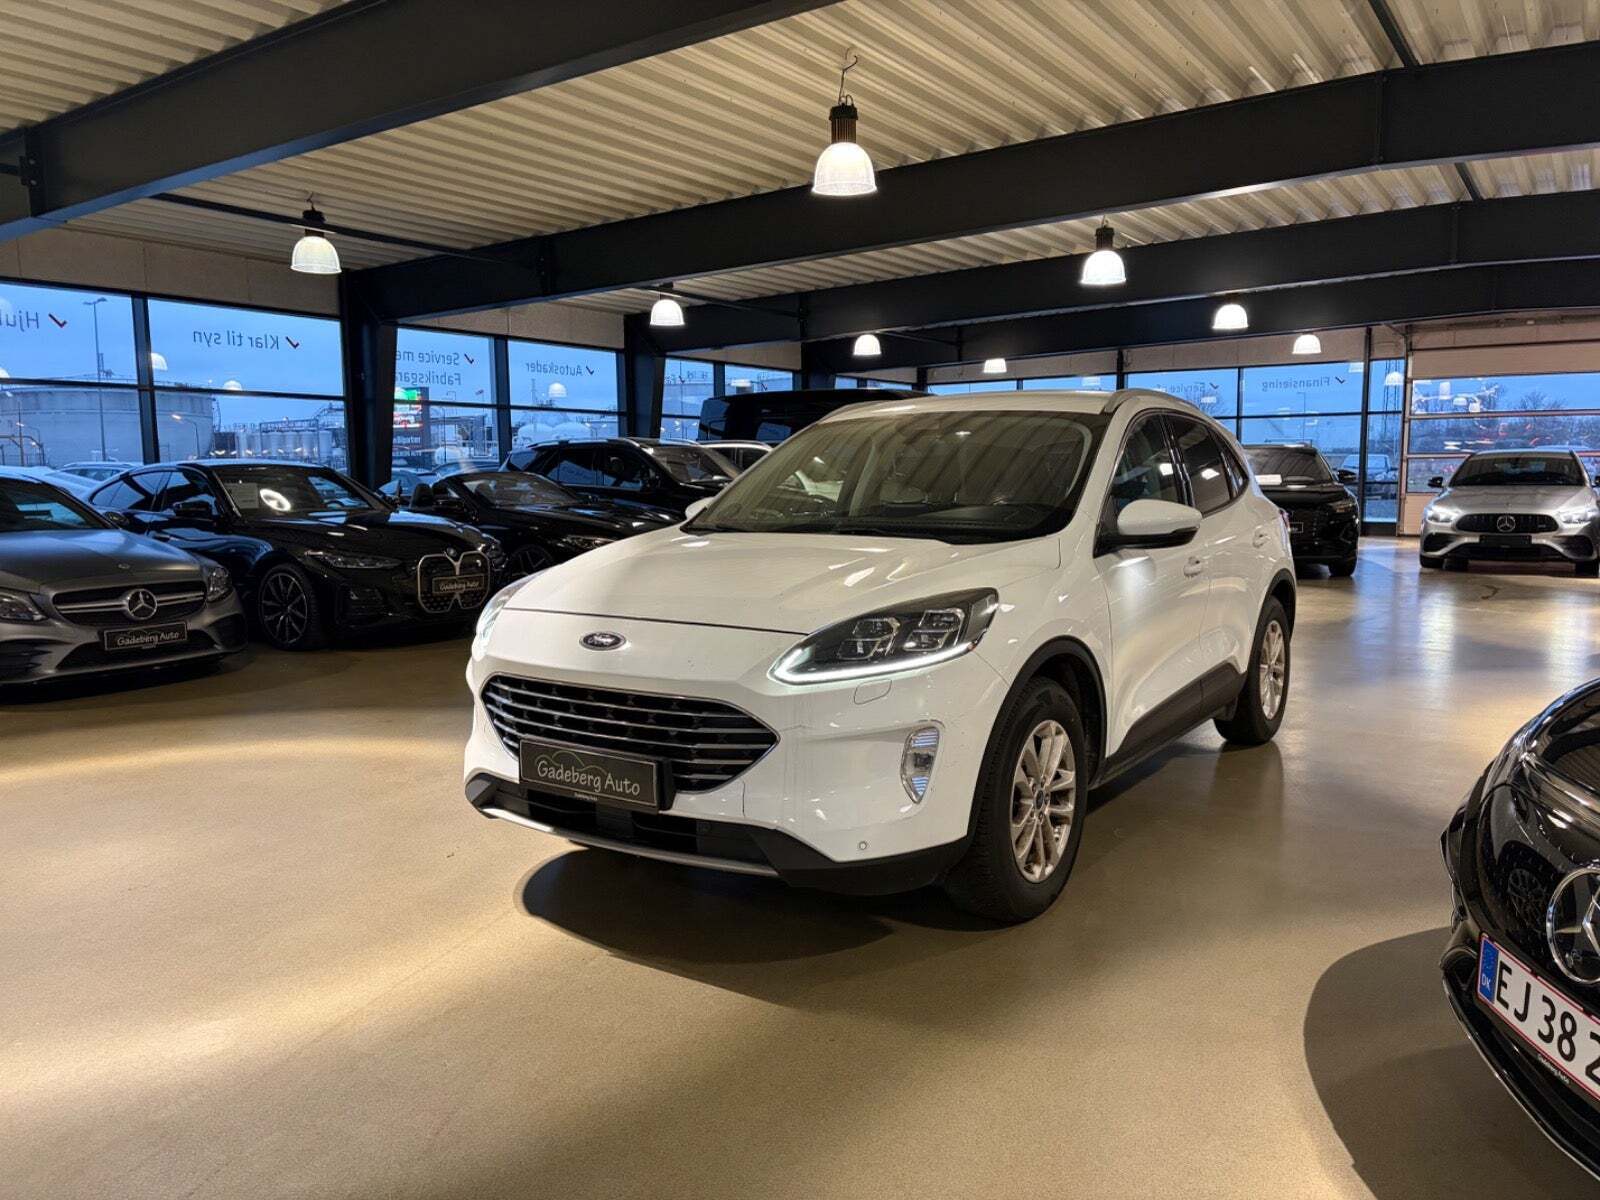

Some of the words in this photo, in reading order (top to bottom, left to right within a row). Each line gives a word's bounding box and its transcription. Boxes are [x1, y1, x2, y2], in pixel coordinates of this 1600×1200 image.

[536, 760, 601, 793] Gadeberg
[604, 772, 641, 797] Auto
[1481, 973, 1492, 992] DK
[1496, 960, 1532, 1023] EJ
[1537, 994, 1578, 1063] 38
